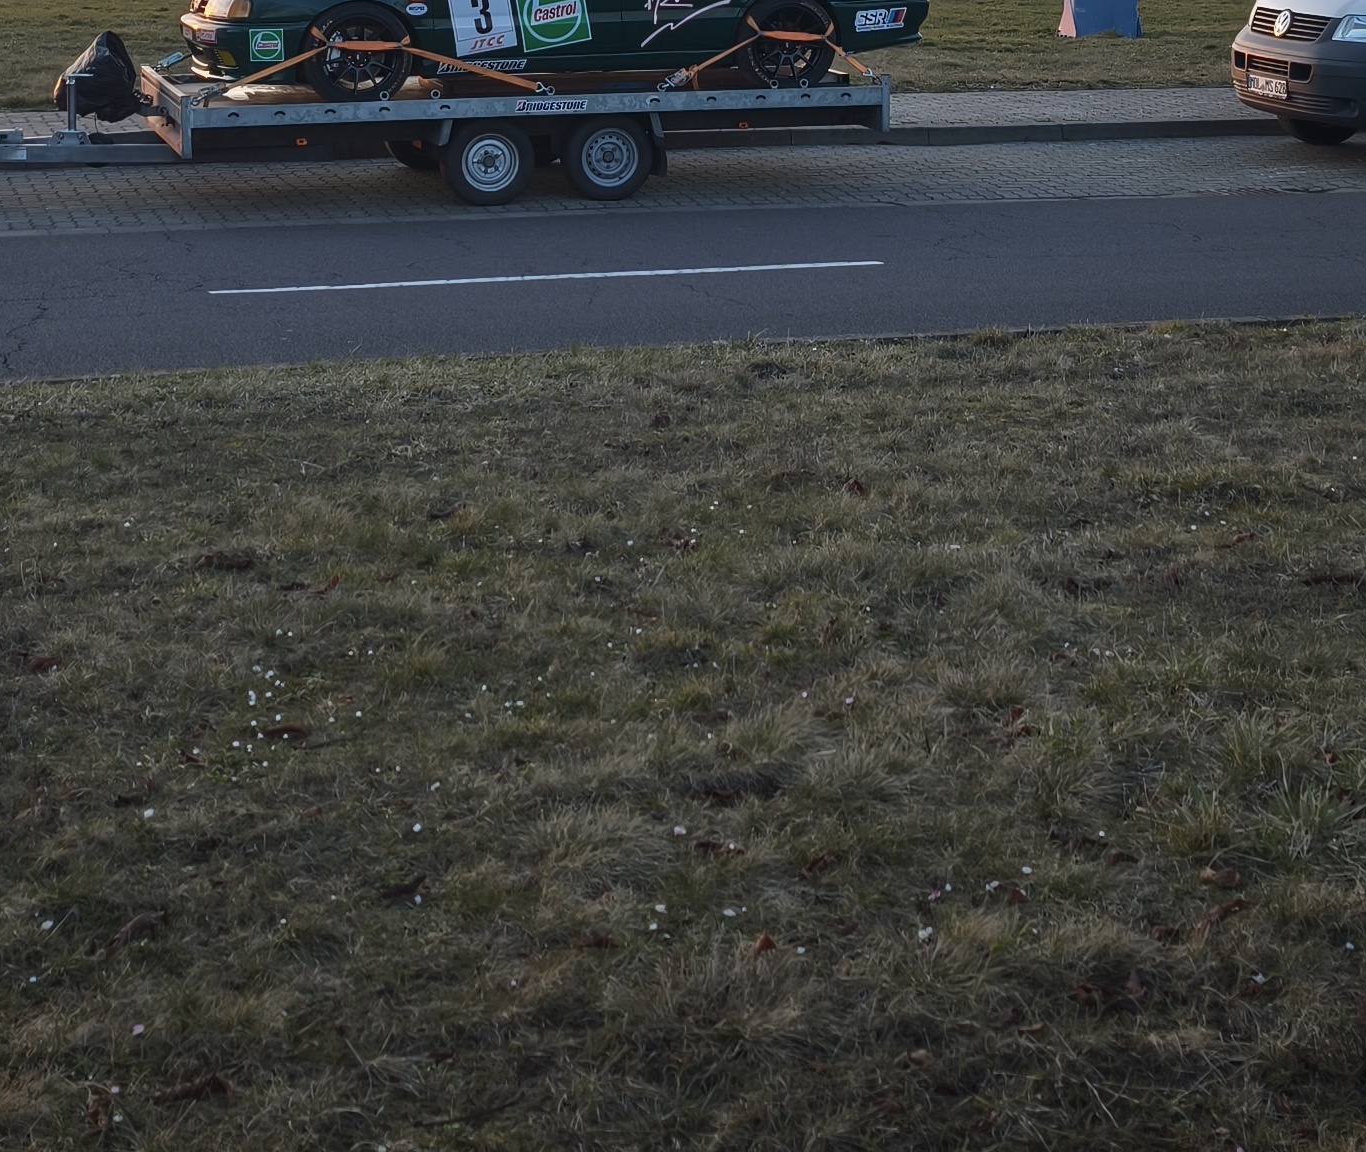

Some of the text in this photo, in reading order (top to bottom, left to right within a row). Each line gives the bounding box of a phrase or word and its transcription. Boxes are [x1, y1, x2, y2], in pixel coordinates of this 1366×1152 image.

[534, 0, 577, 23] Castrol
[856, 9, 888, 25] SSR
[470, 35, 506, 50] JTCC
[516, 99, 587, 112] BRIDGESTONE
